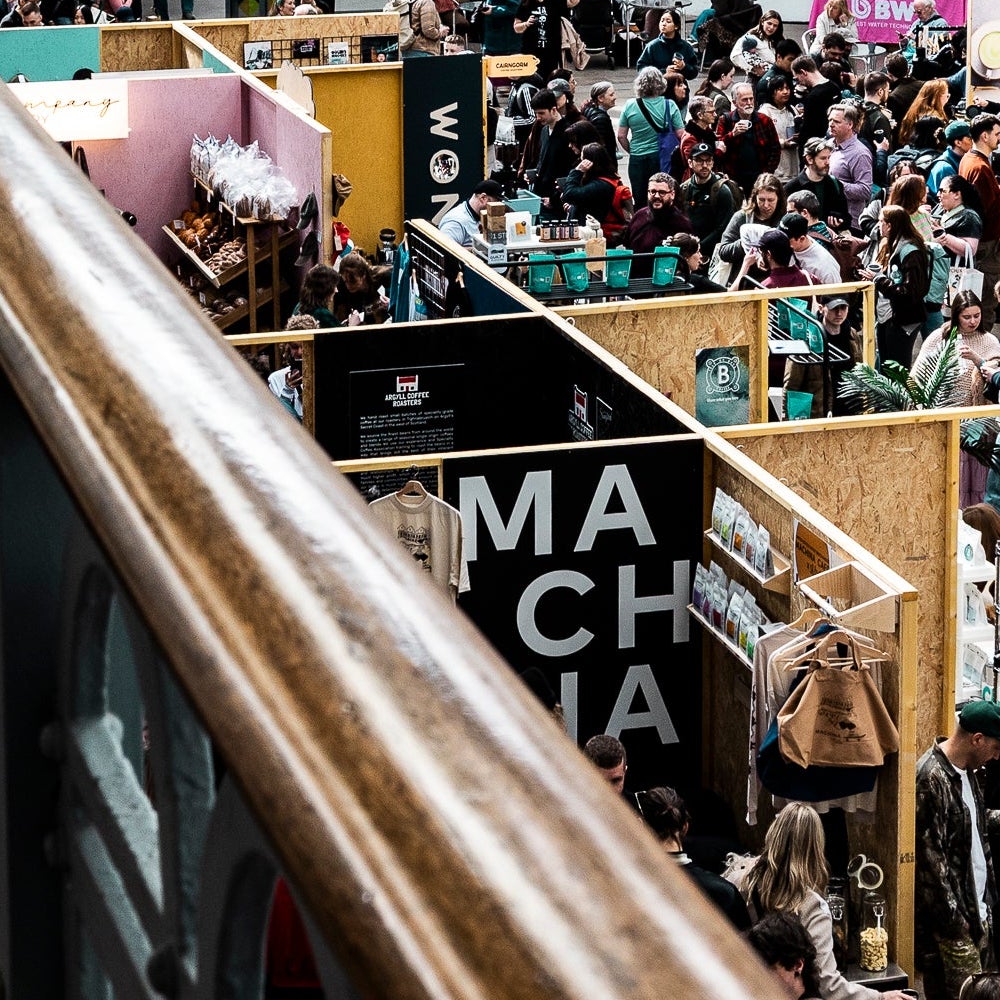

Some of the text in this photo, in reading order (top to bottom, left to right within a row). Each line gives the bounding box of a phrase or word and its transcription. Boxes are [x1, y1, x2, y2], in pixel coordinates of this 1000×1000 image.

[874, 0, 915, 22] BW
[889, 22, 912, 30] TECHNO
[718, 364, 730, 385] B
[385, 391, 430, 401] ARGYLL COFFEE
[392, 399, 422, 407] ROASTERS
[458, 463, 657, 562] MA
[516, 559, 691, 657] CH
